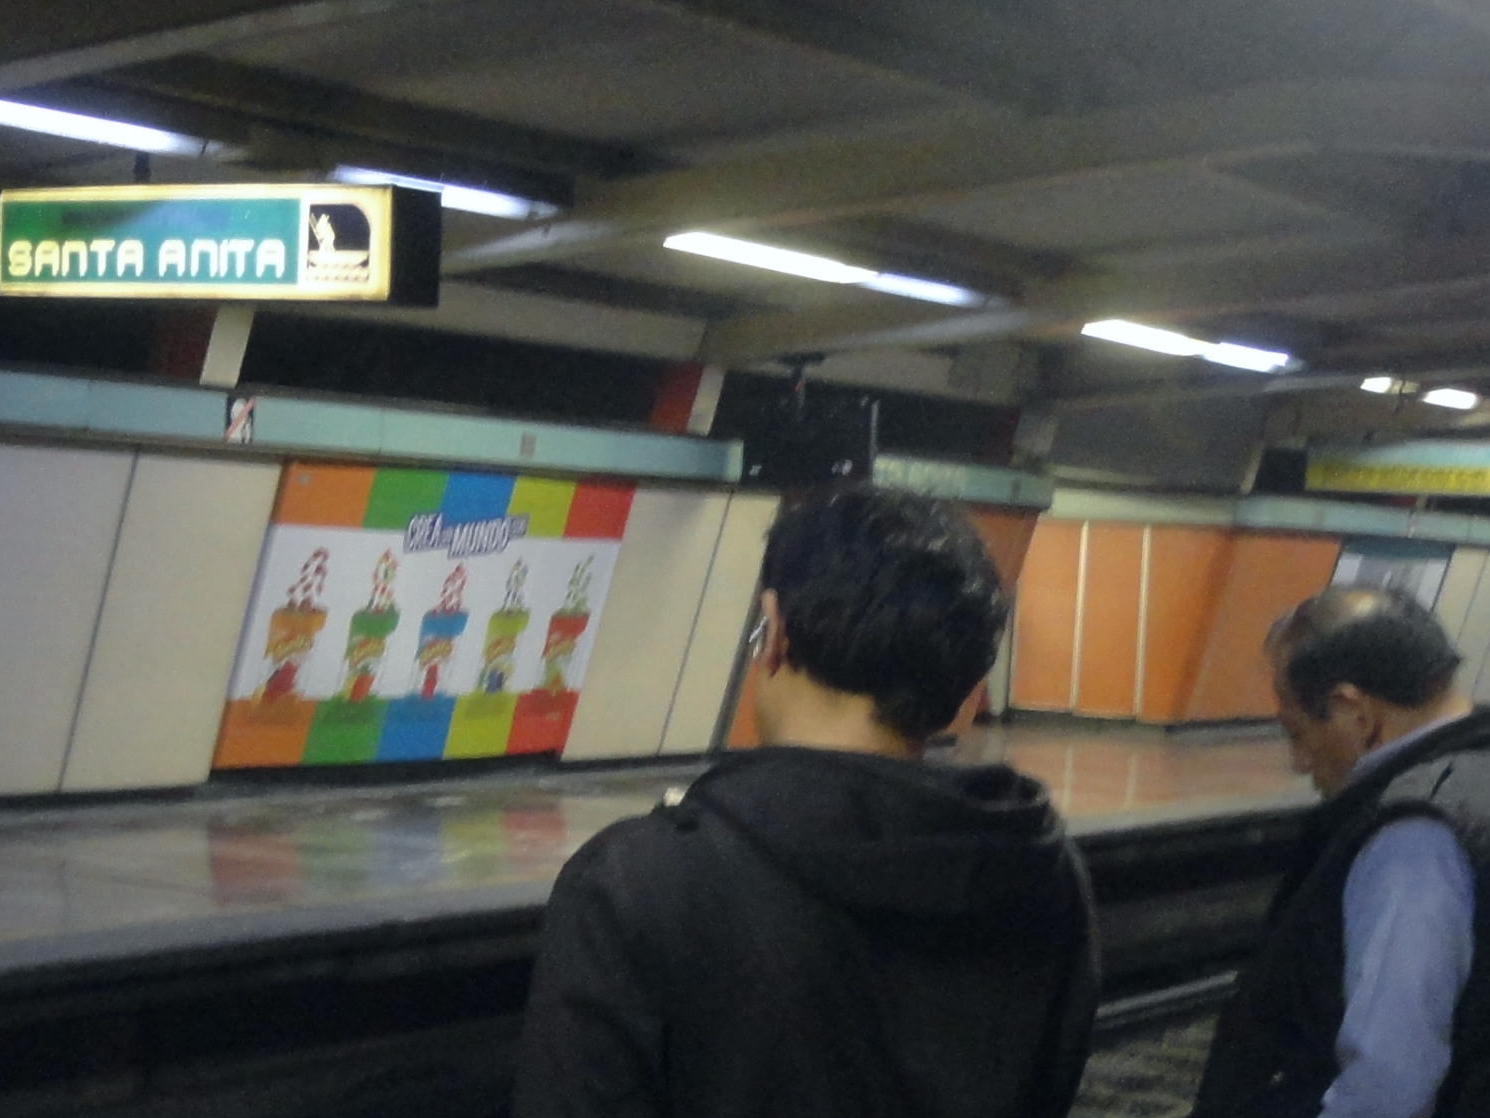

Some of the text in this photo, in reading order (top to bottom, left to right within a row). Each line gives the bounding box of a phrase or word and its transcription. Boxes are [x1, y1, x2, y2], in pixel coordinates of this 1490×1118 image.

[8, 239, 286, 278] SANTA ANITA
[450, 517, 510, 556] MUNDO
